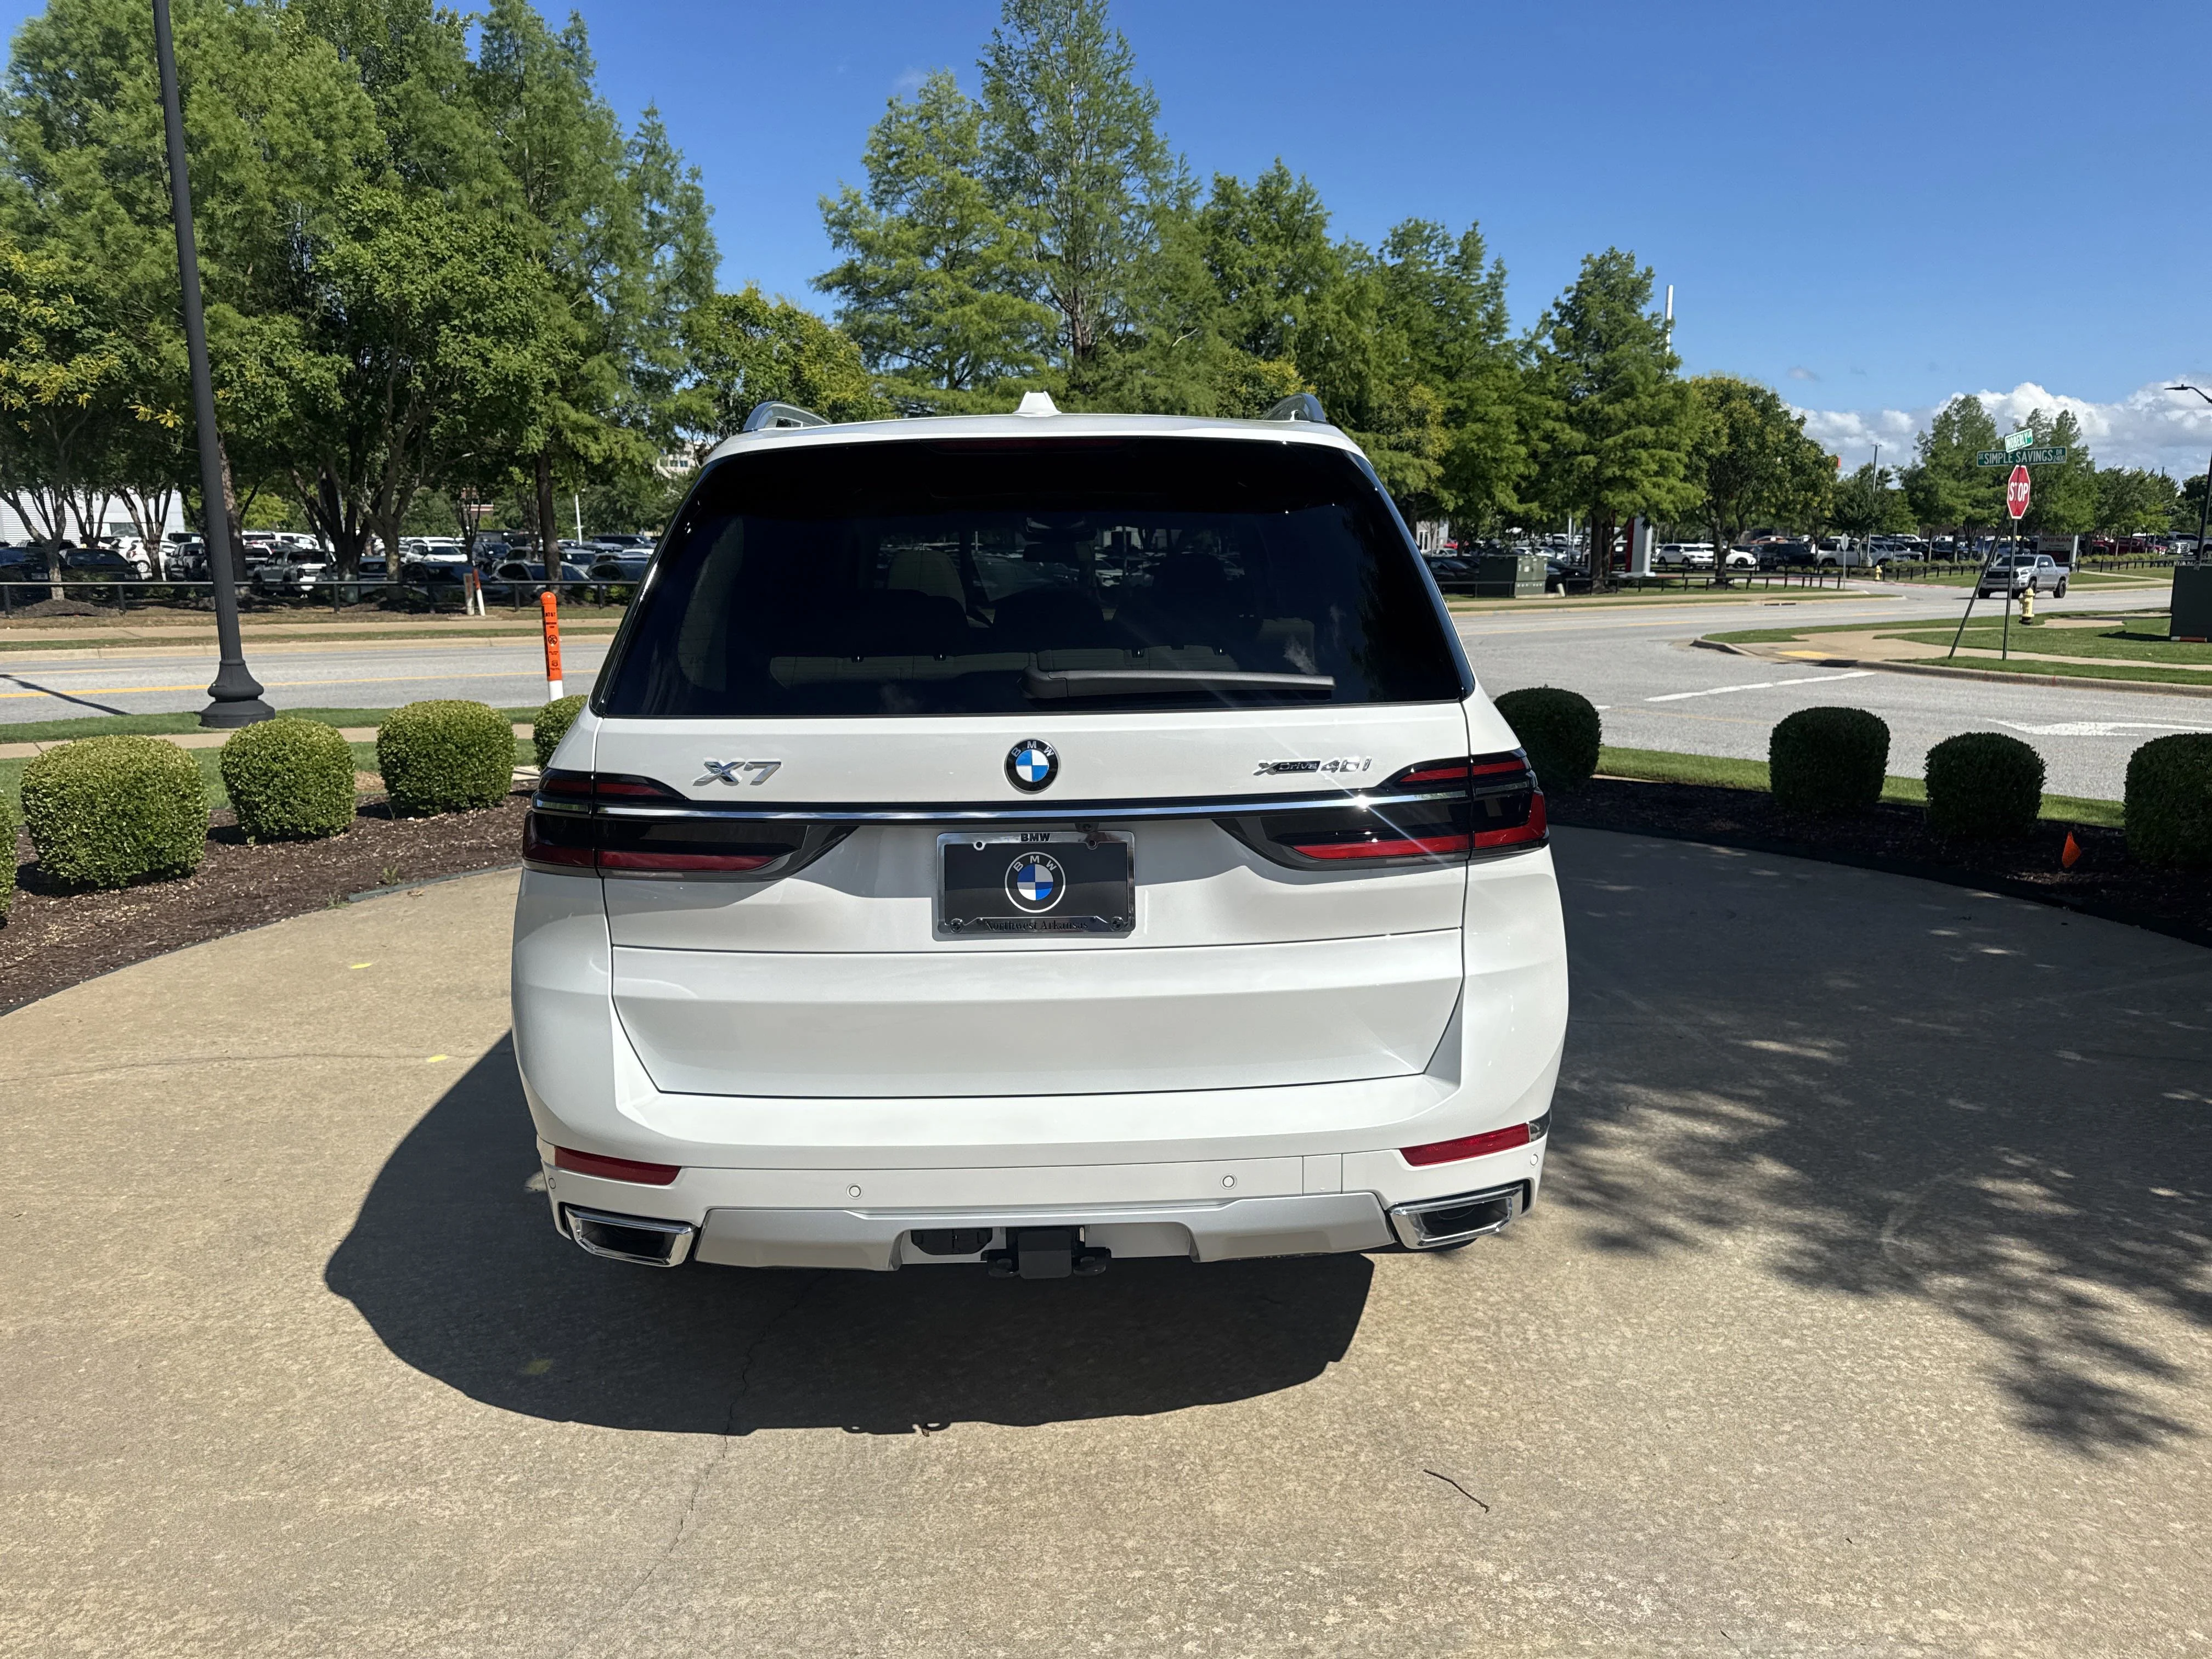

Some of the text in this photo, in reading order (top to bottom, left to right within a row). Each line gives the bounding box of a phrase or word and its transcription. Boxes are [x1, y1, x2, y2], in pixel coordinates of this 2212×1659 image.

[2006, 432, 2028, 451] MOBERLY
[1984, 452, 2013, 465] SIMPLE
[2016, 449, 2053, 463] SAVINGS
[2009, 481, 2029, 502] STOP
[1011, 741, 1054, 757] BMW
[692, 759, 782, 787] X7
[1020, 833, 1050, 842] BMW
[1013, 855, 1058, 872] BMW
[985, 919, 1088, 931] Northwest Arkansas
